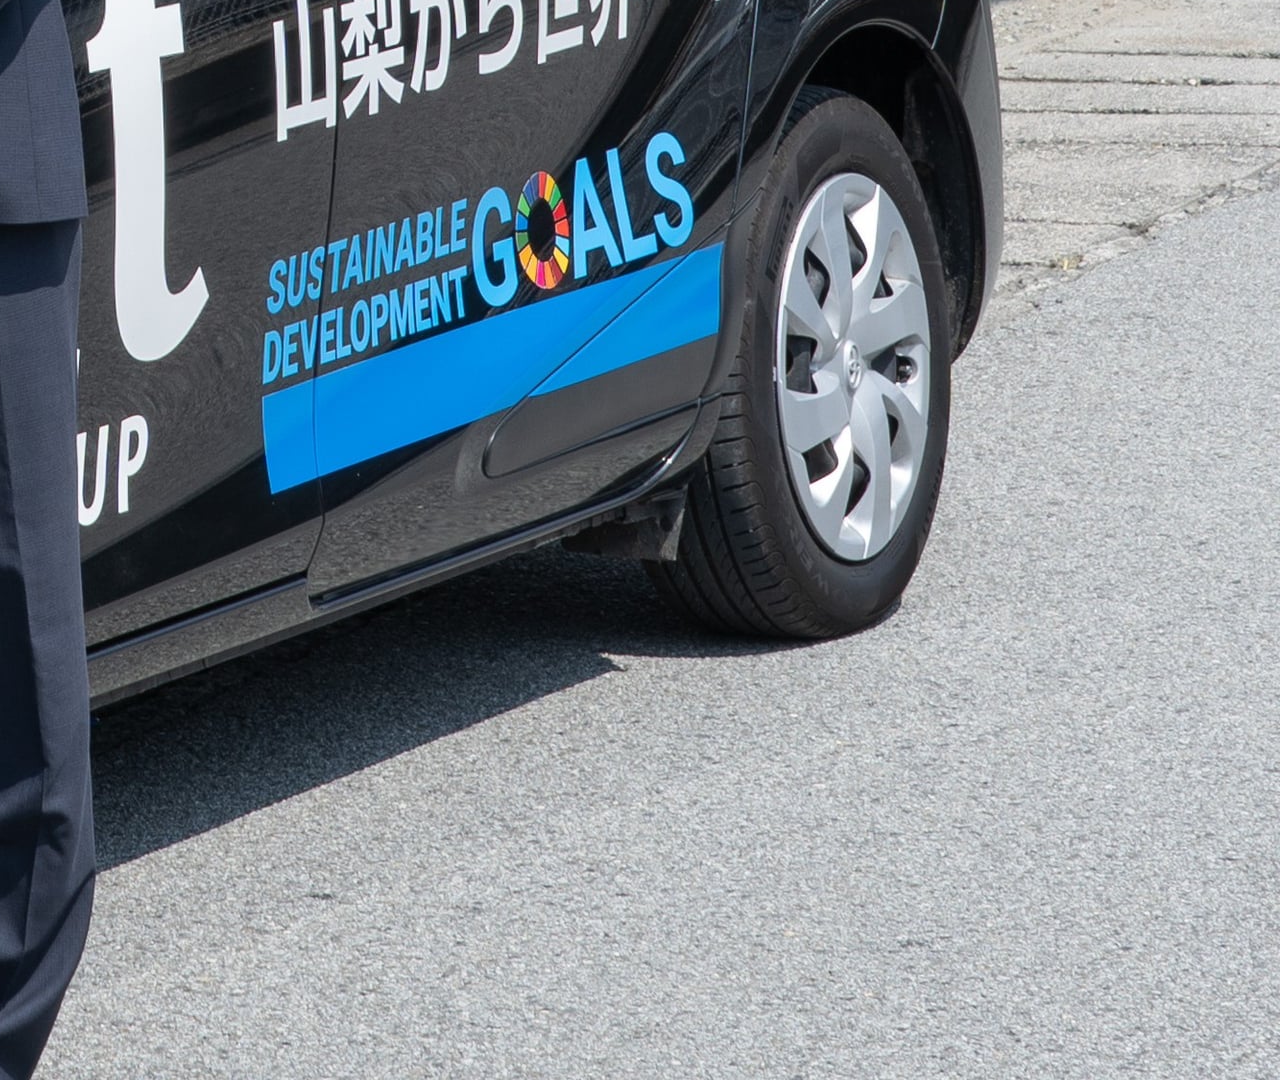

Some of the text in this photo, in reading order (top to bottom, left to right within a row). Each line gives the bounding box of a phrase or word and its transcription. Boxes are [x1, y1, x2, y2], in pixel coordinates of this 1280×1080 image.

[266, 197, 468, 316] SUSTAINABLE
[472, 131, 694, 308] GOALS
[261, 270, 469, 385] DEVELOPMENT
